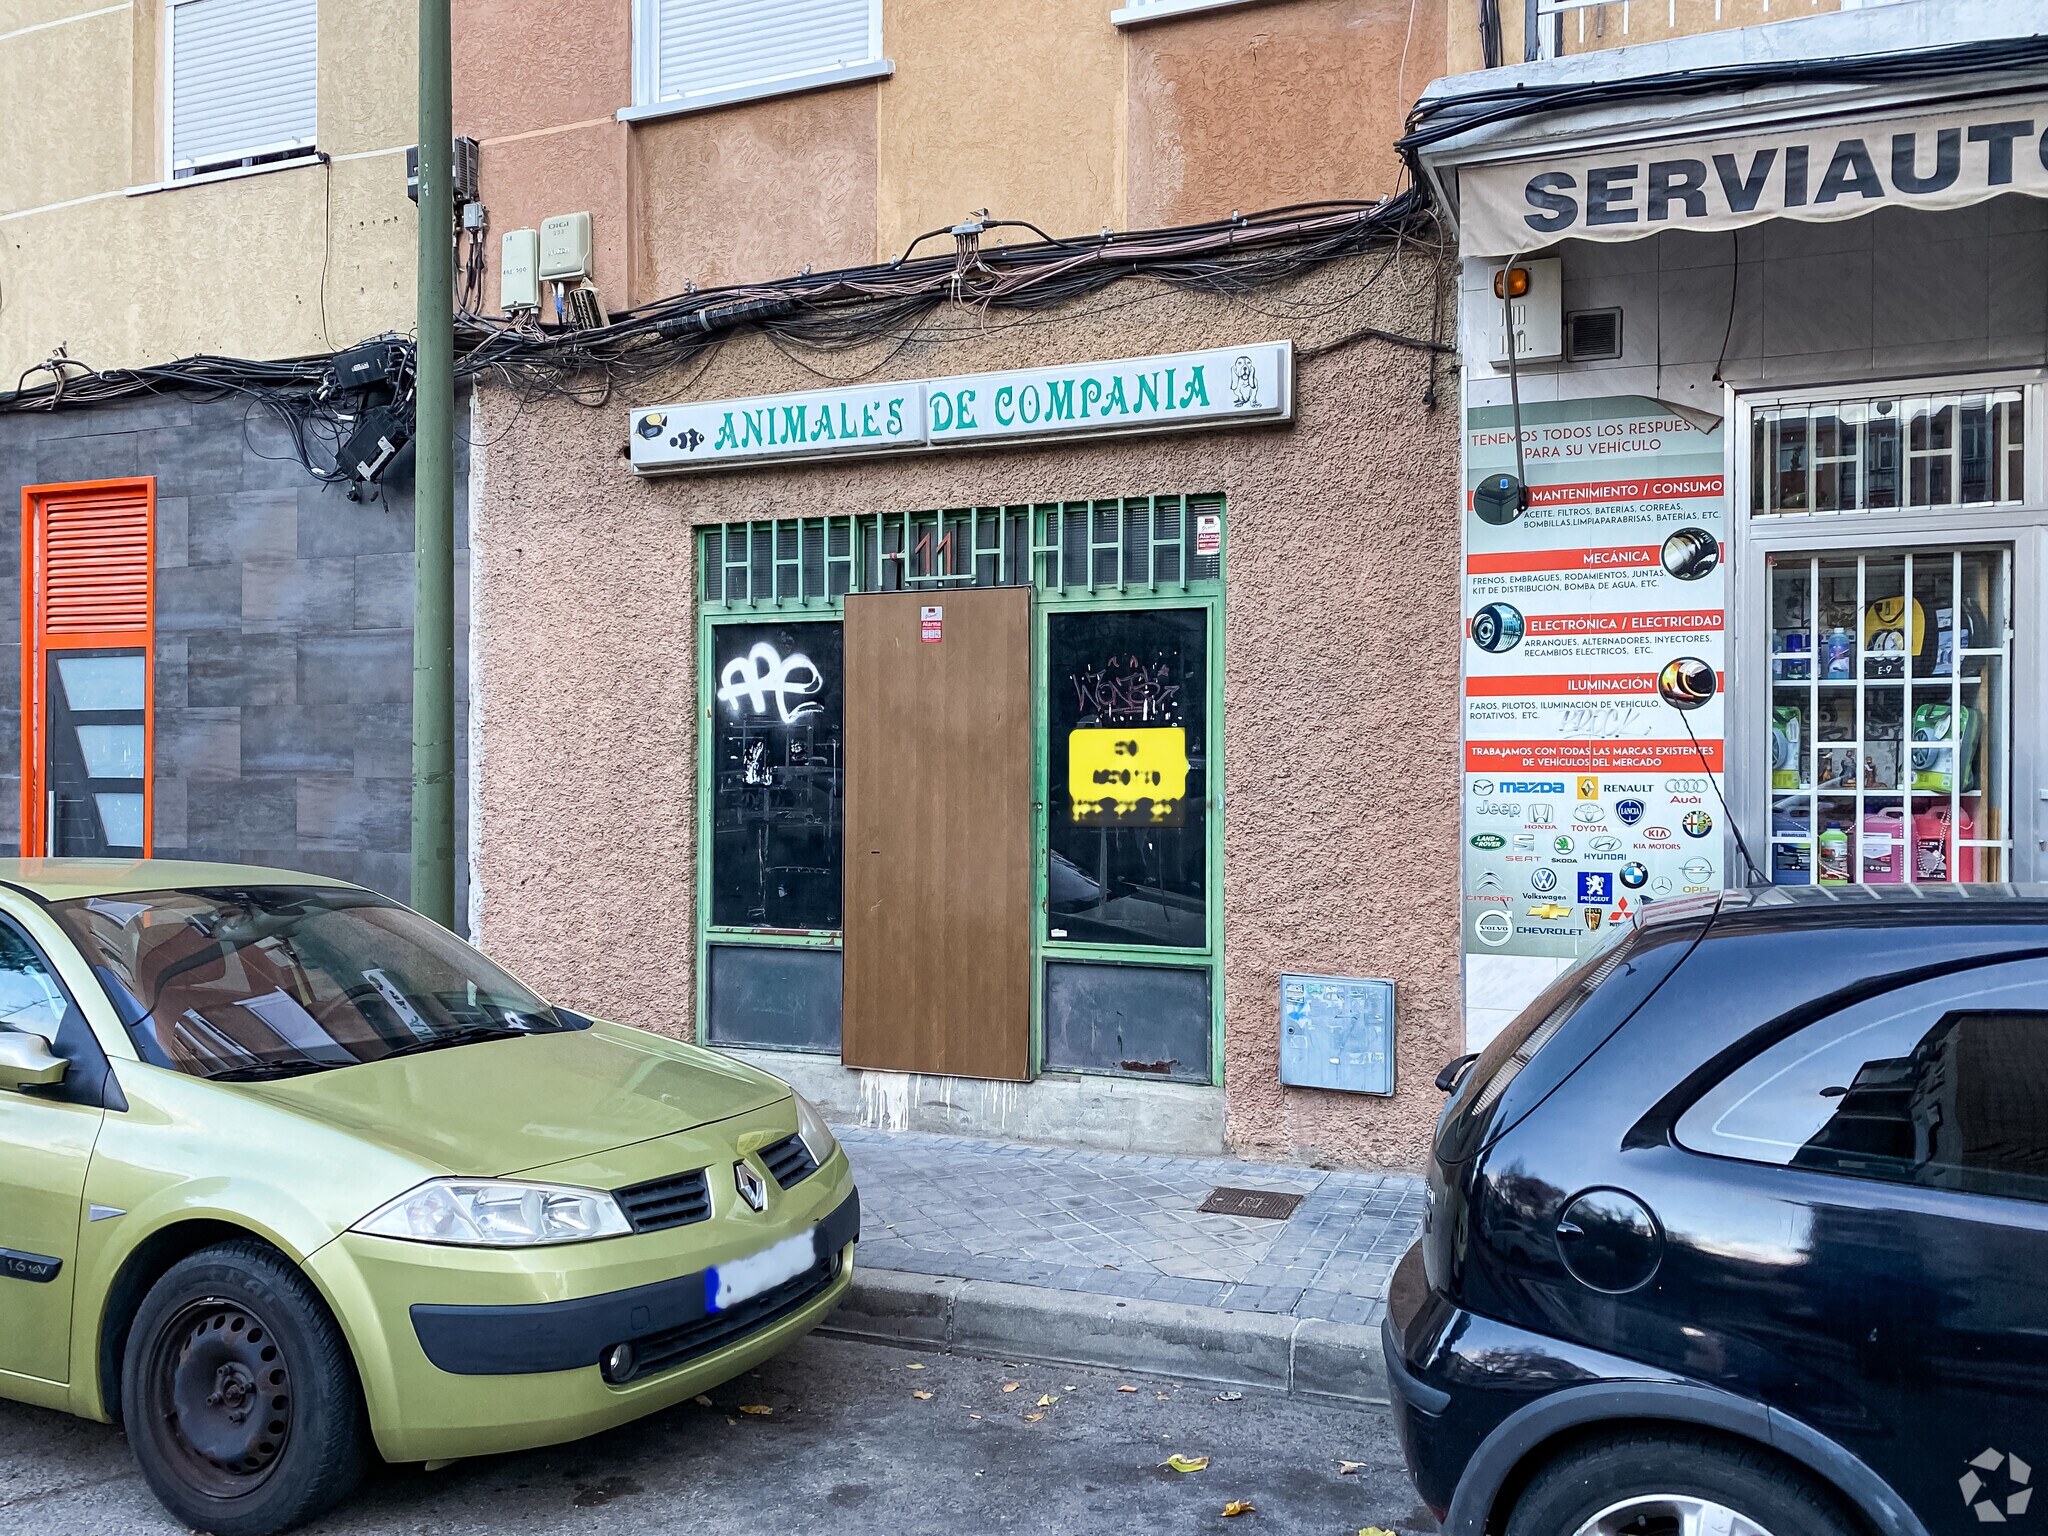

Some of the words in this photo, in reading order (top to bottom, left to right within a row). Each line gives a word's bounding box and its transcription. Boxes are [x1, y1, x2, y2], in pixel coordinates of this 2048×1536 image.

[1524, 119, 2048, 232] SERVIAUT
[549, 221, 569, 229] DIGI
[714, 398, 905, 450] ANIMALES
[929, 390, 978, 432] DE
[994, 365, 1211, 427] COMPANIA
[1472, 430, 1538, 447] TENEMOS
[1543, 426, 1592, 441] TODOS
[1597, 423, 1624, 437] LOS
[1629, 418, 1720, 435] RESPUES
[1525, 446, 1561, 459] PARA
[1566, 443, 1583, 456] SU
[1588, 438, 1662, 454] VEHÍCULO
[1532, 485, 1639, 502] MANTENIMIENTO
[1653, 480, 1723, 494] CONSUMO
[1557, 507, 1593, 516] FILTROS,
[1639, 502, 1684, 512] CORREAS,
[1702, 511, 1722, 519] ETC.
[914, 532, 951, 575] 11
[1583, 549, 1650, 564] MECÁNICA
[1472, 587, 1486, 595] KIT
[1488, 586, 1499, 594] DE
[1564, 582, 1596, 591] BOMBA
[1598, 582, 1609, 590] DE
[1641, 579, 1660, 588] ETC.
[1531, 616, 1618, 632] ELECTRÓNICA
[1631, 614, 1722, 629] ELECTRICIDAD
[1524, 648, 1573, 657] RECAMBIOS
[1634, 646, 1653, 654] ETC.
[1568, 677, 1653, 691] ILUMINACIÓN
[1600, 700, 1612, 708] DE
[1522, 711, 1541, 719] ETC.
[1472, 747, 1532, 758] TRABAJAMOS
[1534, 747, 1557, 756] CON
[1559, 746, 1590, 756] TODAS
[1593, 746, 1611, 756] LAS
[1613, 747, 1653, 756] MARCAS
[1522, 758, 1535, 767] DE
[1537, 757, 1590, 767] VEHÍCULOS
[1592, 758, 1611, 767] DEL
[1613, 758, 1662, 767] MERCADO
[1604, 784, 1654, 792] RENAULT
[1670, 795, 1701, 803] Audi
[1476, 800, 1521, 818] Jeep
[1571, 825, 1608, 833] TOYOTA
[1648, 829, 1667, 838] KIA
[1584, 853, 1627, 861] HYUNDAI
[1522, 892, 1567, 901] Volkswagen
[1516, 926, 1583, 936] CHEVROLET
[8, 1259, 26, 1272] 1.6
[28, 1264, 48, 1275] 16V
